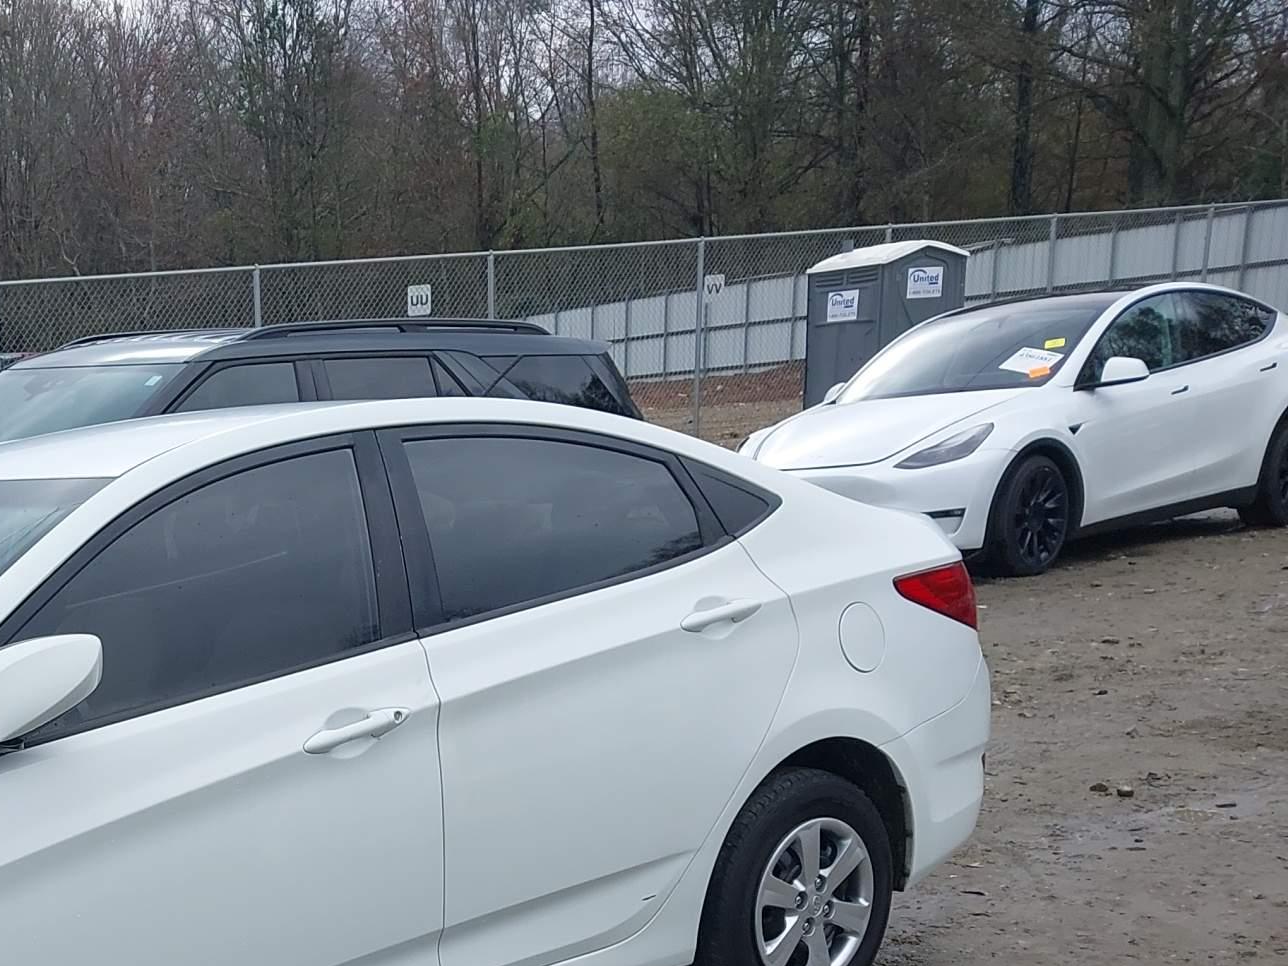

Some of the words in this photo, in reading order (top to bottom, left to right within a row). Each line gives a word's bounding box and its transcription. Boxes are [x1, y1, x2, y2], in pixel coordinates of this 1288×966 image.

[913, 273, 940, 284] United
[410, 293, 429, 306] UU
[831, 296, 855, 307] United
